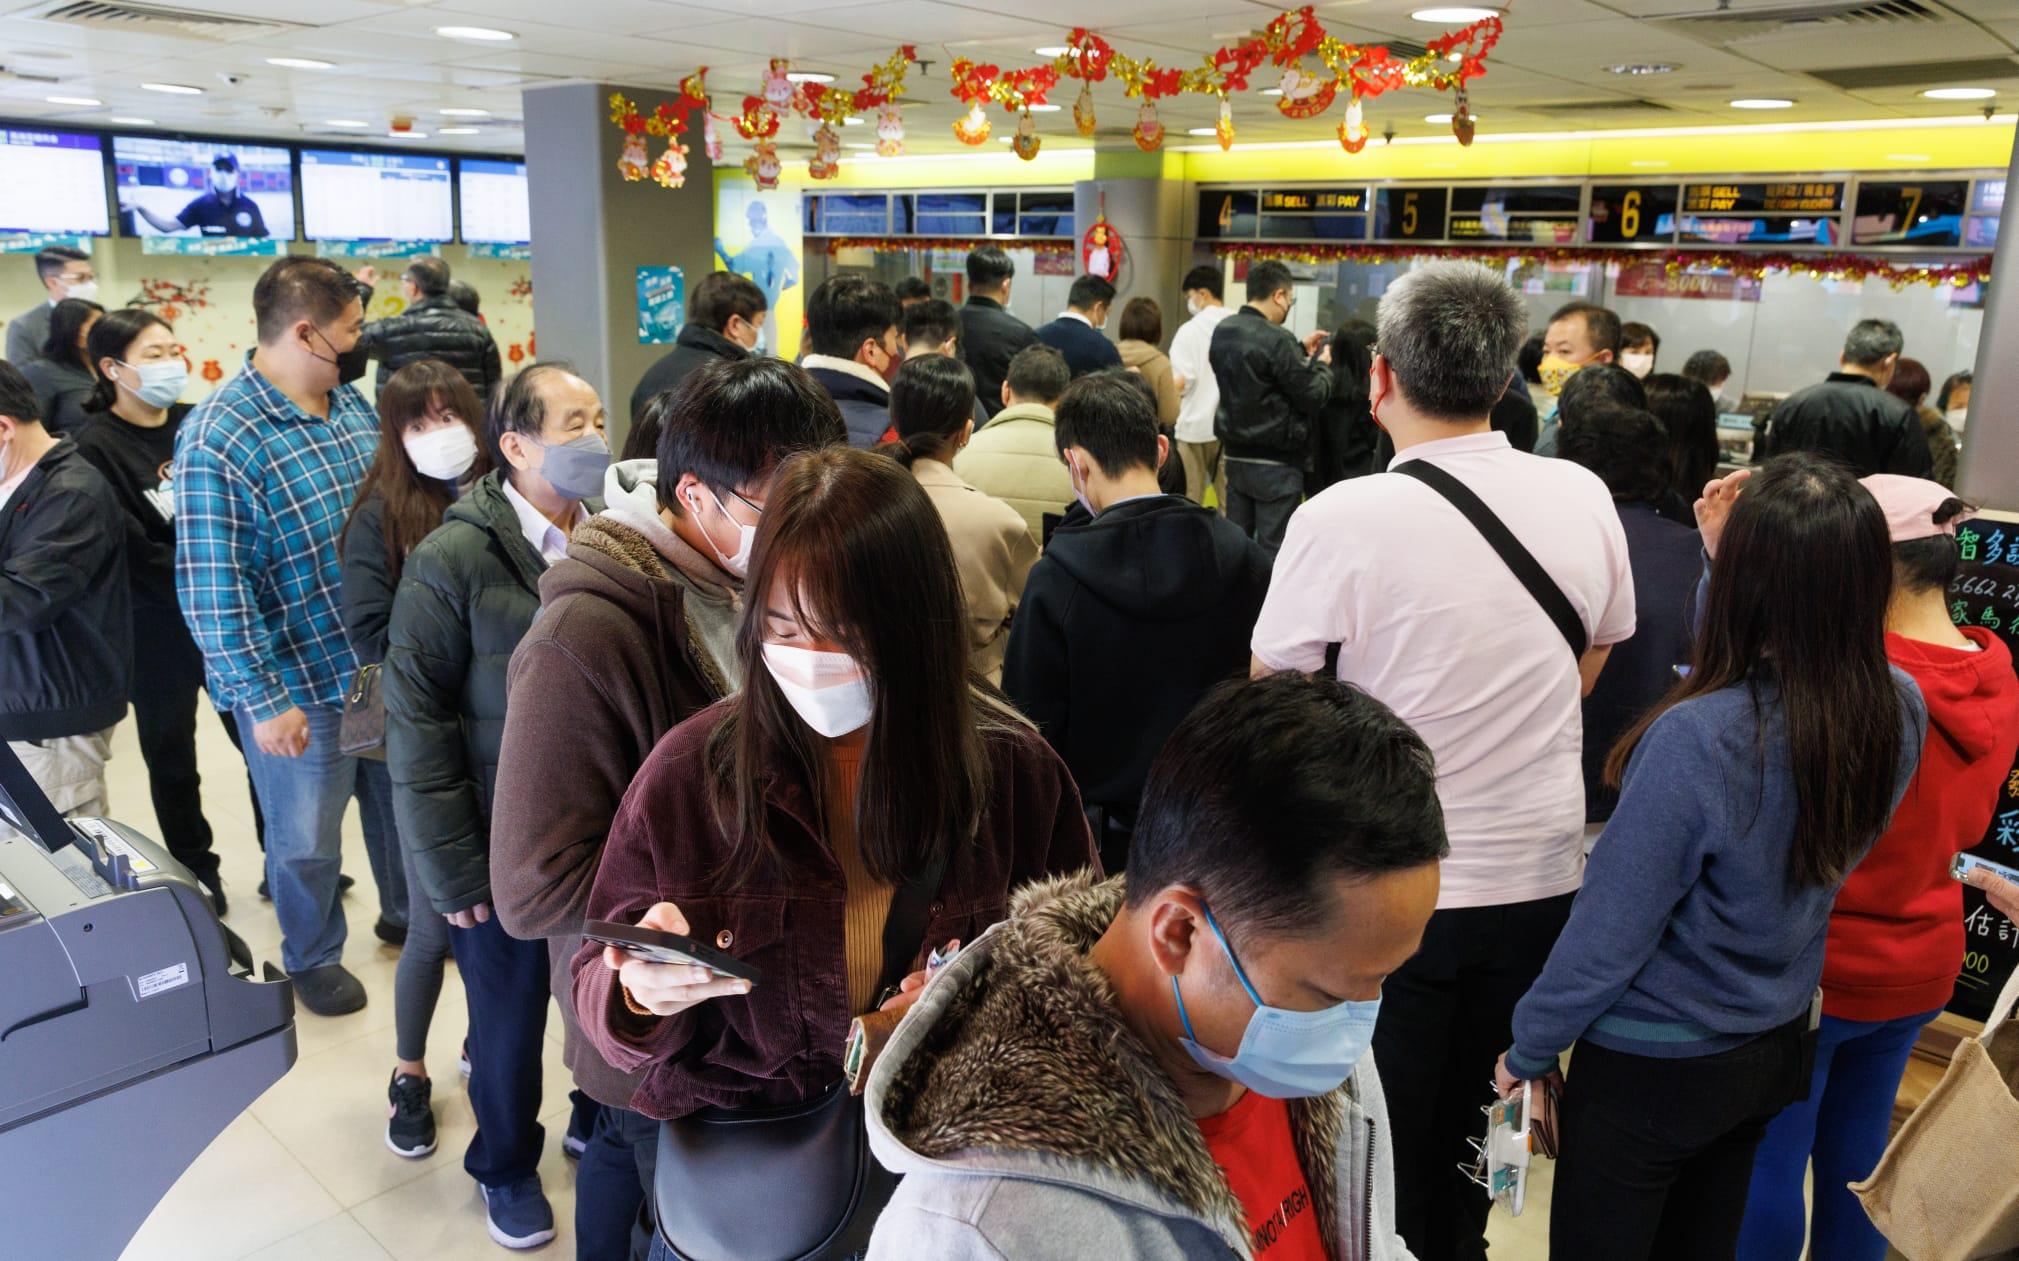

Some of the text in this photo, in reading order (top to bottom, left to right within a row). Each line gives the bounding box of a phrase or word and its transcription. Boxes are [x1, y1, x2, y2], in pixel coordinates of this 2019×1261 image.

[1284, 194, 1309, 208] SELL
[1337, 194, 1360, 208] PAY
[1711, 185, 1741, 198] SELL
[1218, 194, 1233, 229] 4
[1402, 192, 1419, 235] 5
[1620, 189, 1642, 238] 6
[1710, 199, 1736, 210] PAY
[1901, 187, 1923, 233] 7
[1963, 951, 1989, 974] 00
